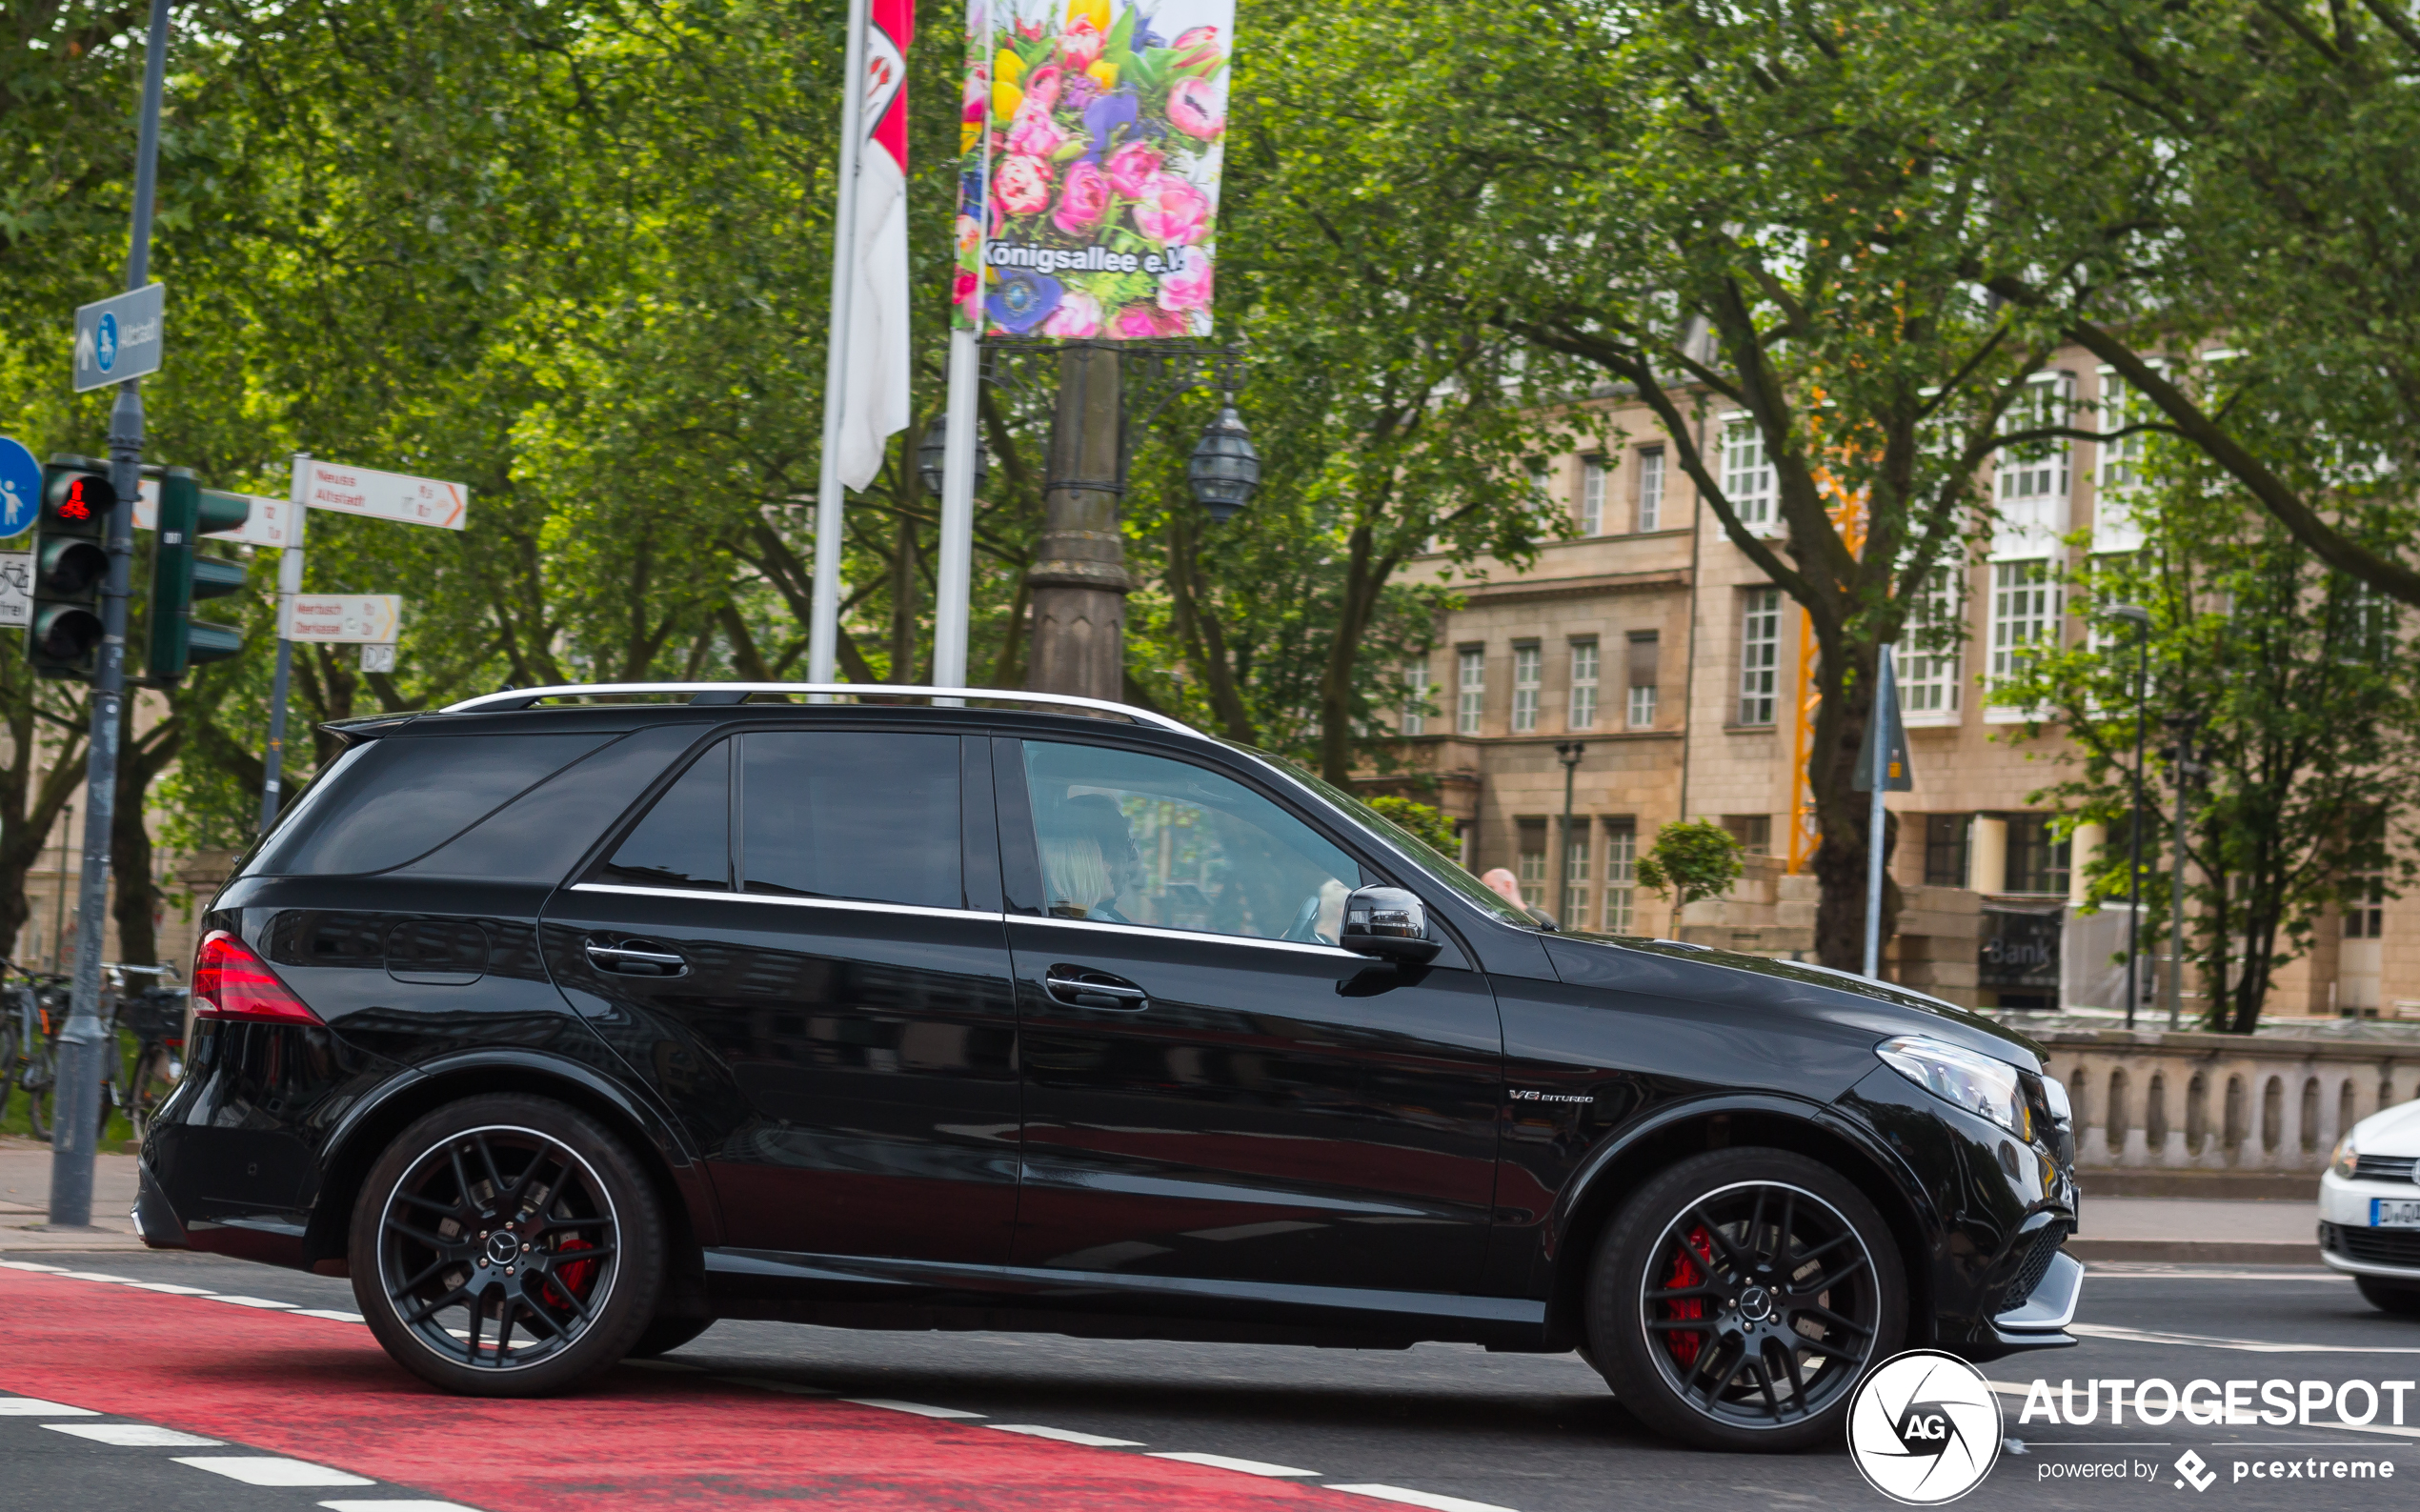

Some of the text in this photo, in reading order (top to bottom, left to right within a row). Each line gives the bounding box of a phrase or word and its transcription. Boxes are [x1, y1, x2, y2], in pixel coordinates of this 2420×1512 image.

[316, 469, 356, 487] Neuss
[315, 488, 366, 507] Altstadt
[1987, 937, 2051, 965] Bank
[1509, 1090, 1594, 1103] V8 BITURBO
